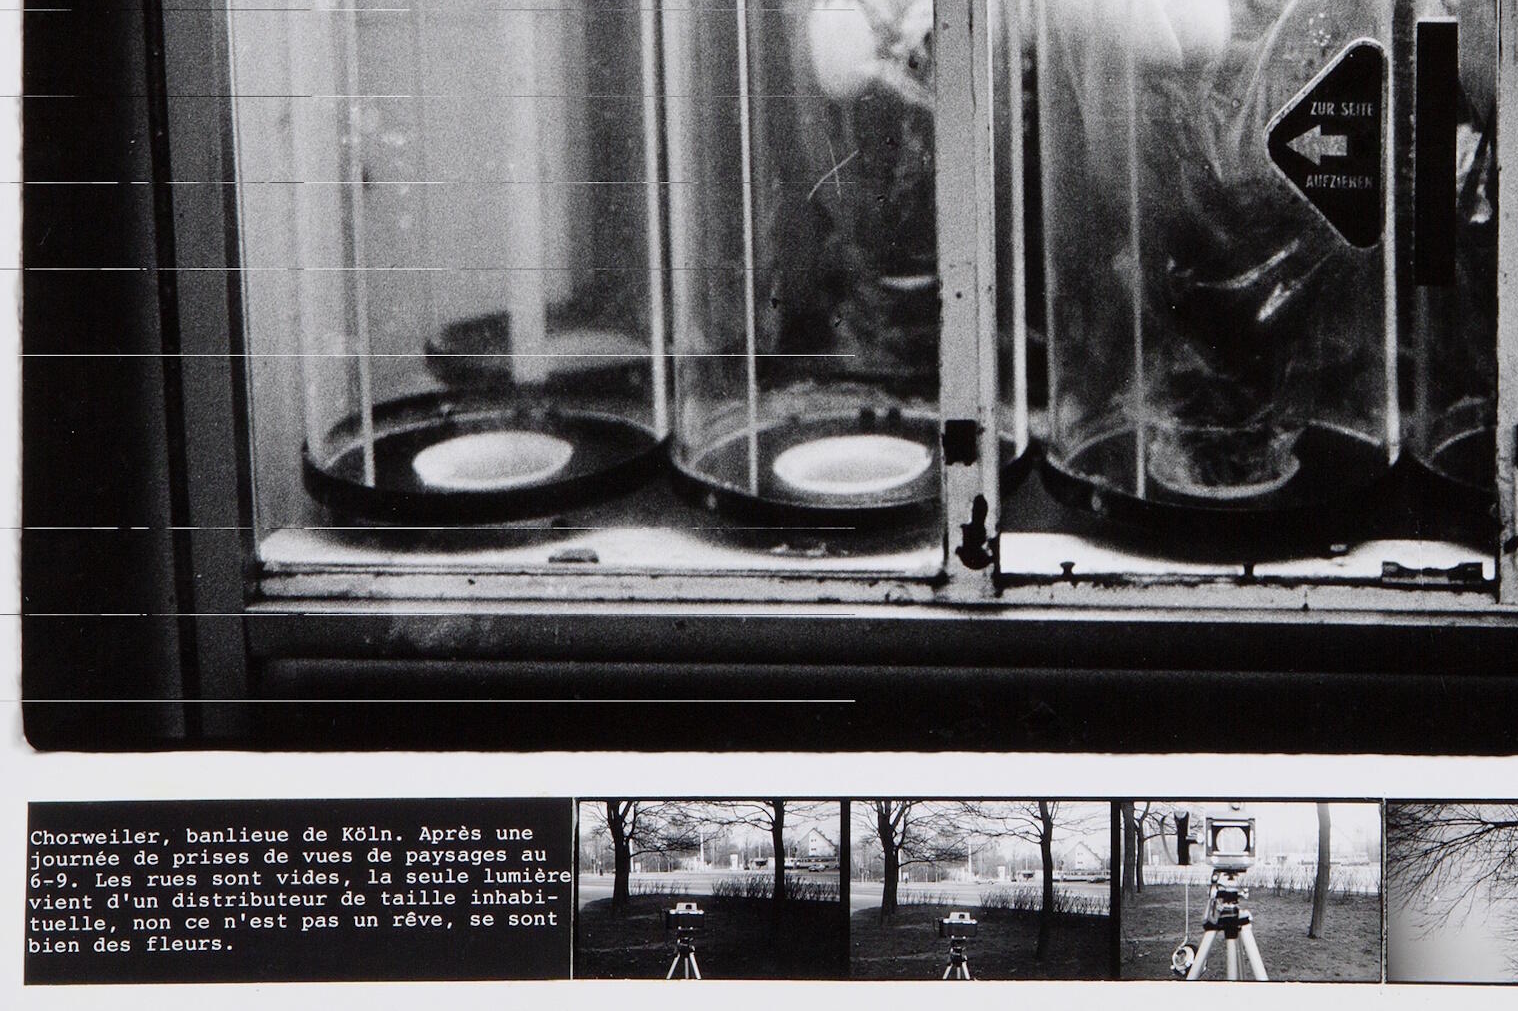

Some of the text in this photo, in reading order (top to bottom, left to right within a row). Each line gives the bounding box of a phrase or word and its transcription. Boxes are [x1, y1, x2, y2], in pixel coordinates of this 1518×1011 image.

[1309, 102, 1374, 116] ZUR SEITE
[31, 826, 533, 847] Chorweiler, banlieue de Köln. Après une
[30, 848, 547, 870] journée de prises de vues de paysages au
[30, 867, 572, 888] 6-9. Les rues sont vides, la seule lumière
[29, 889, 559, 909] vient d'un distributeur de taille inhabi-
[30, 912, 558, 934] tuelle, non ce n'est pas un rêve, se sont
[29, 935, 233, 953] bien des fleurs.
